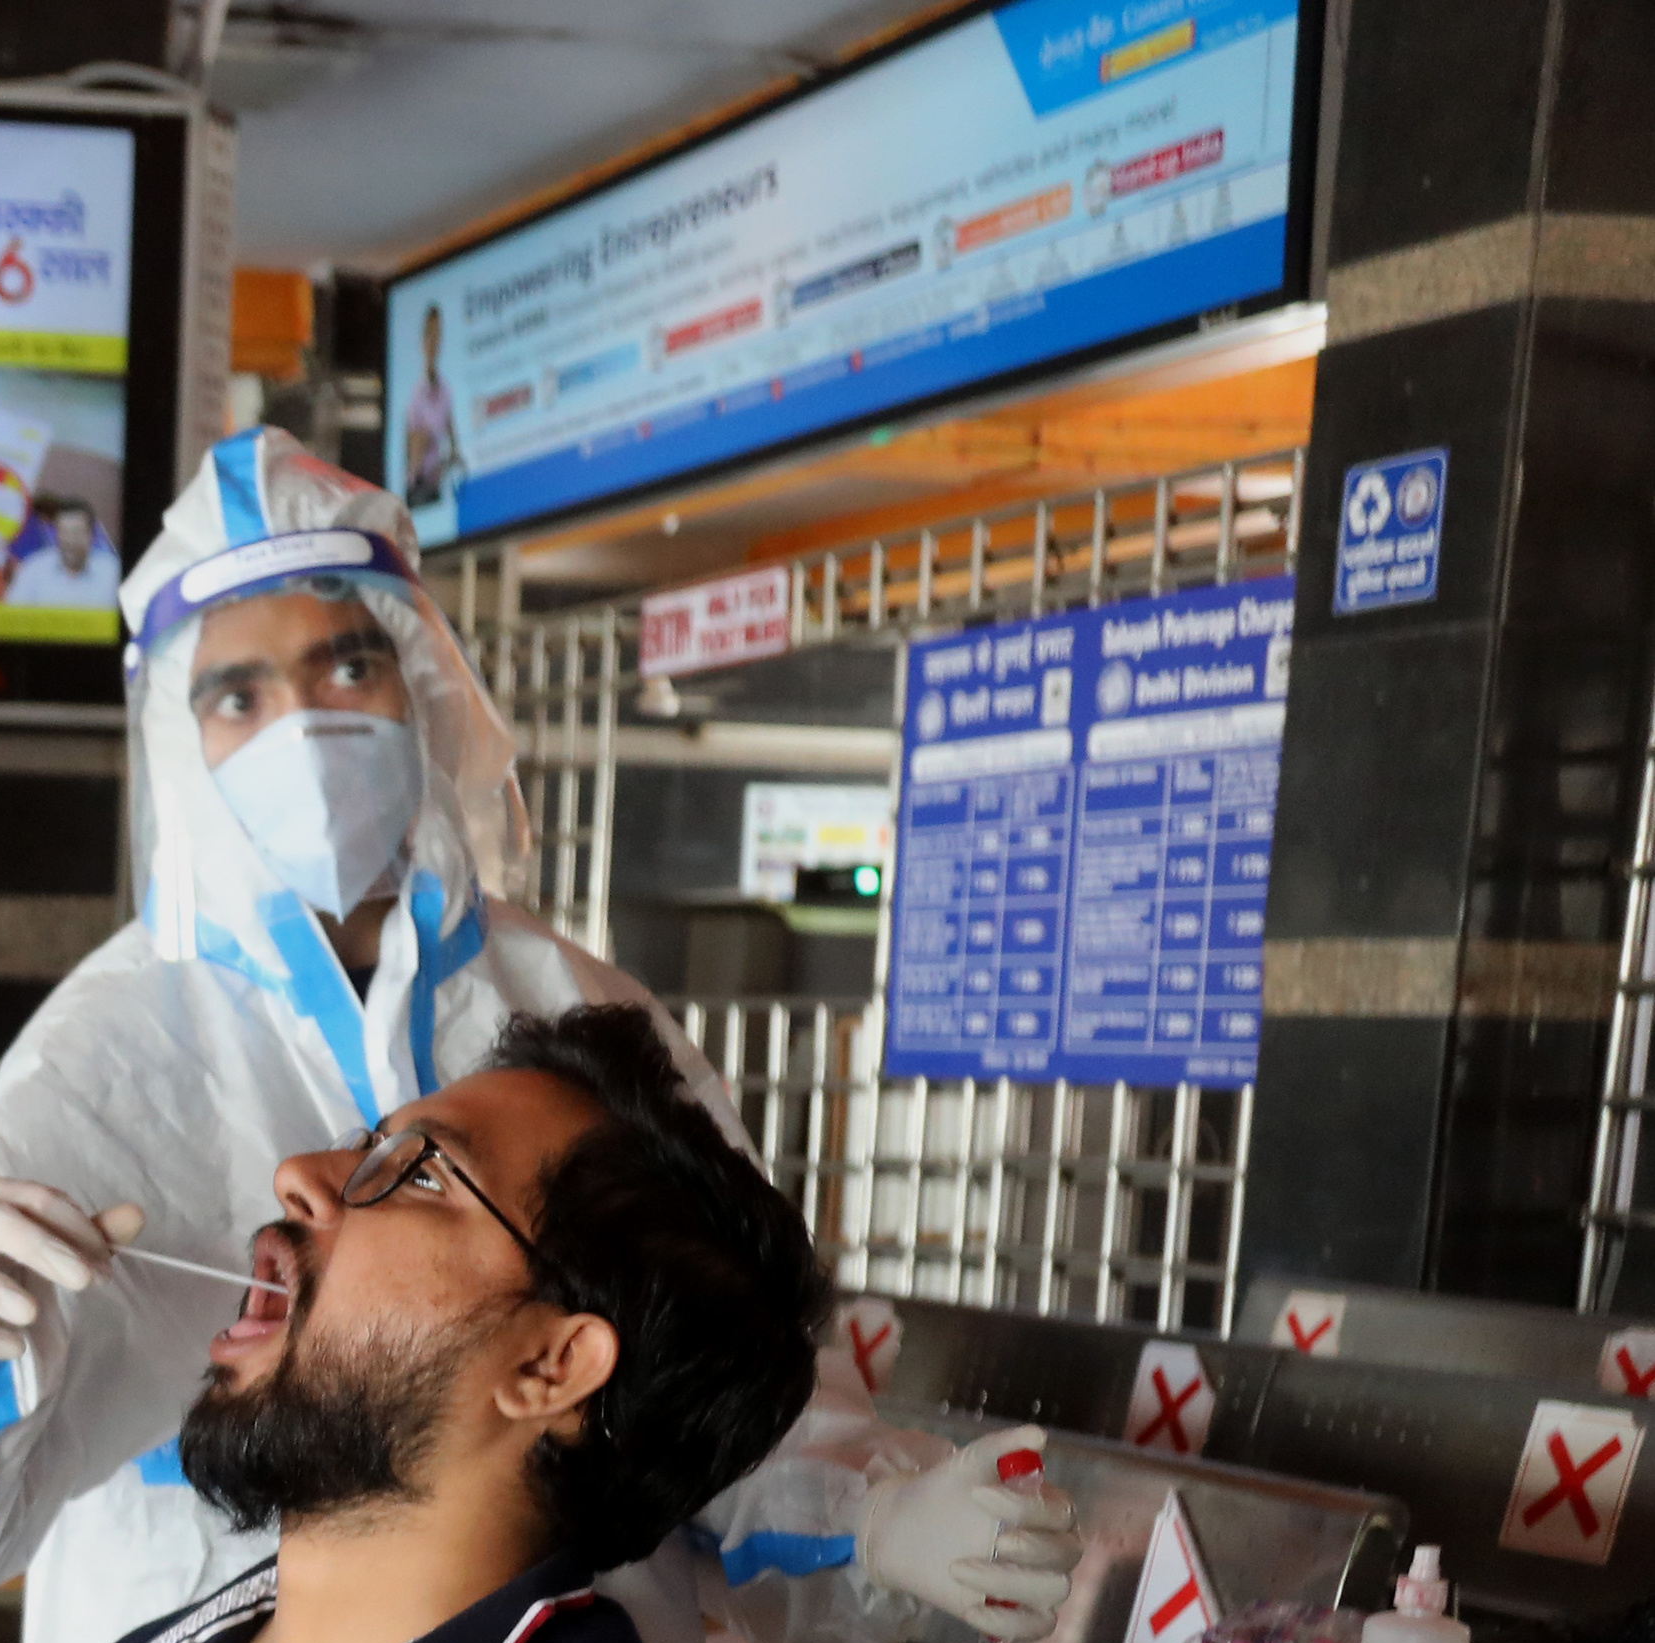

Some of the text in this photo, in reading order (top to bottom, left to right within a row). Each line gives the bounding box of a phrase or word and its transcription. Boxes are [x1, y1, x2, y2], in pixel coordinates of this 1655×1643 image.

[463, 245, 593, 326] Empowering
[600, 159, 778, 267] Entrepreneurs
[1101, 597, 1295, 660] Sahayak Porterage Charge
[1135, 663, 1255, 706] Delhi Division
